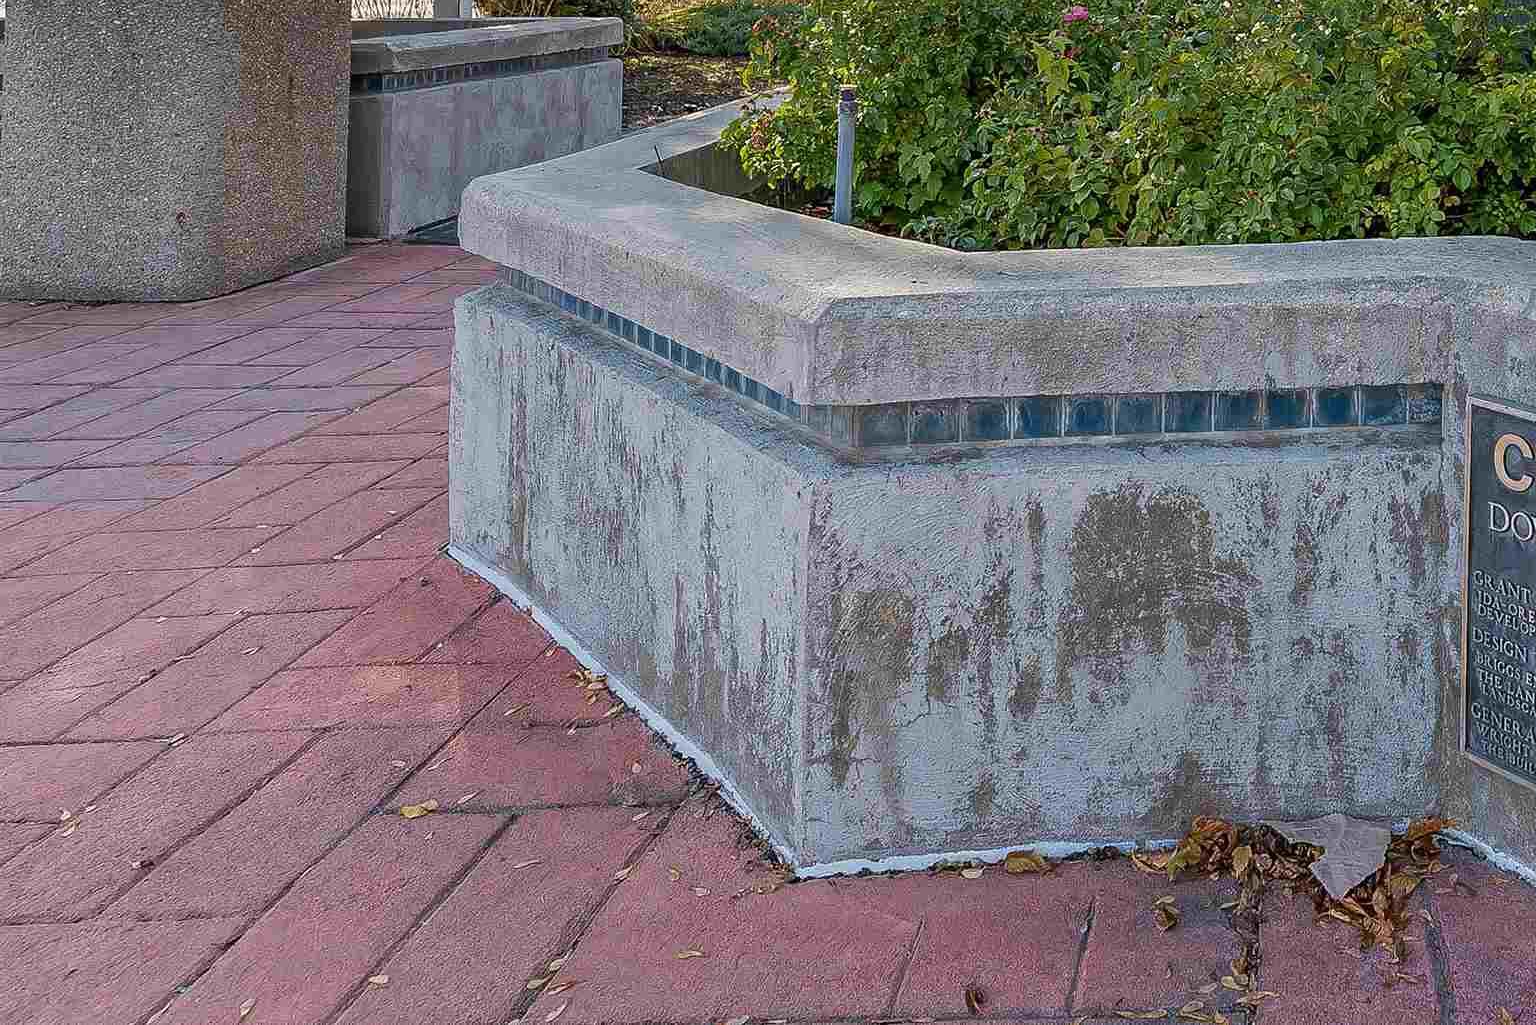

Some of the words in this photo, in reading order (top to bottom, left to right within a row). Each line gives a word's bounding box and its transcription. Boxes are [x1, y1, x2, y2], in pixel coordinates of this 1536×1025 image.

[1473, 571, 1531, 603] GRANT
[1478, 591, 1536, 623] IDA-ORE
[1472, 627, 1528, 663] DESIGN
[1475, 651, 1521, 679] BRIGGS
[1478, 669, 1502, 689] THE
[1476, 722, 1530, 758] WRIGHT
